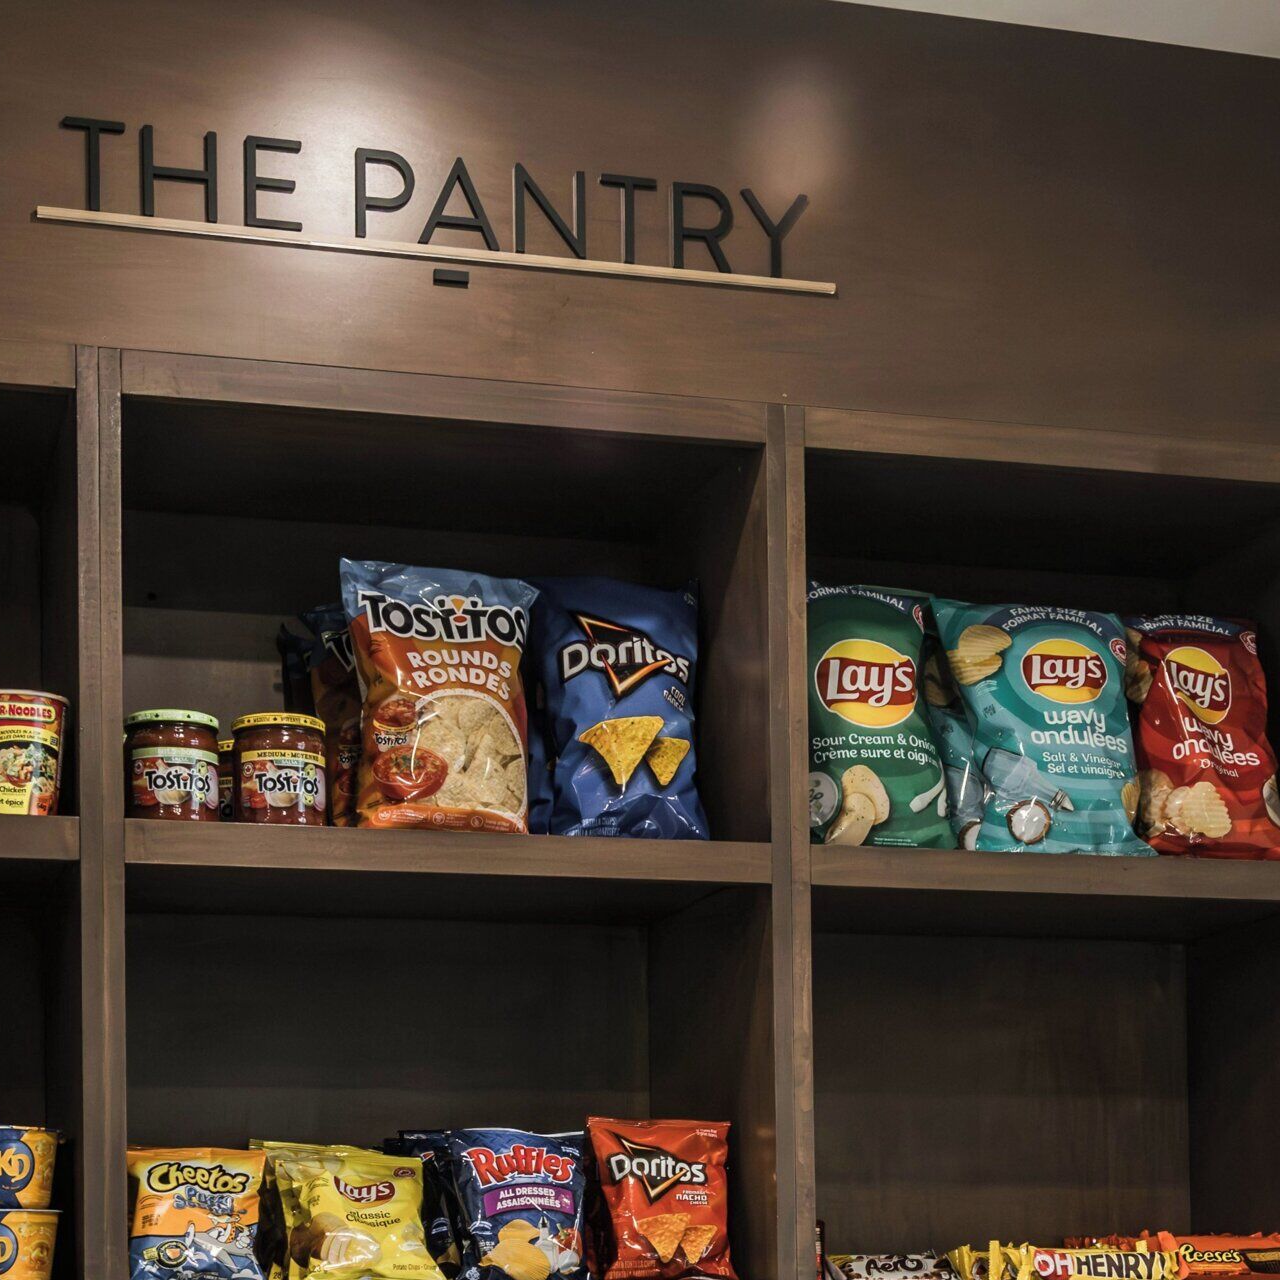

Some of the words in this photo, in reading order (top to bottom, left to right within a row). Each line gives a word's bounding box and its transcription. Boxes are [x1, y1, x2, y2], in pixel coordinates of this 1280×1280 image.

[61, 116, 302, 233] THE
[354, 148, 809, 279] PANTRY
[1002, 611, 1046, 632] FORMAT
[1049, 612, 1104, 636] FAMILIAL
[1009, 606, 1053, 616] FAMILY
[1056, 607, 1086, 618] SIZE
[1177, 620, 1231, 636] FAMILIAL
[406, 650, 512, 679] ROUNDS
[562, 636, 691, 683] Doritos
[1031, 655, 1102, 689] Lay's
[411, 667, 511, 700] RONDES
[825, 659, 914, 708] Lay's
[1171, 662, 1227, 708] Lay's
[8, 704, 51, 718] NOODLES
[1043, 709, 1105, 733] wavy
[812, 735, 846, 750] Sour
[848, 733, 894, 745] Cream
[1031, 725, 1127, 754] ondulées
[814, 748, 858, 764] Crème
[860, 749, 891, 760] sure
[893, 749, 906, 759] et
[1042, 751, 1067, 763] Salt
[1081, 754, 1122, 770] Vinegar
[1047, 763, 1066, 774] Sel
[1068, 765, 1079, 774] et
[147, 1162, 249, 1194] Cheetos
[467, 1145, 576, 1188] Ruffles
[610, 1154, 705, 1182] Doritos
[339, 1180, 390, 1203] Lay's
[499, 1189, 515, 1199] ALL
[516, 1187, 555, 1197] DRESSED
[1034, 1253, 1074, 1277] OH
[1076, 1251, 1166, 1280] HENRY!
[1178, 1243, 1242, 1263] Reese's
